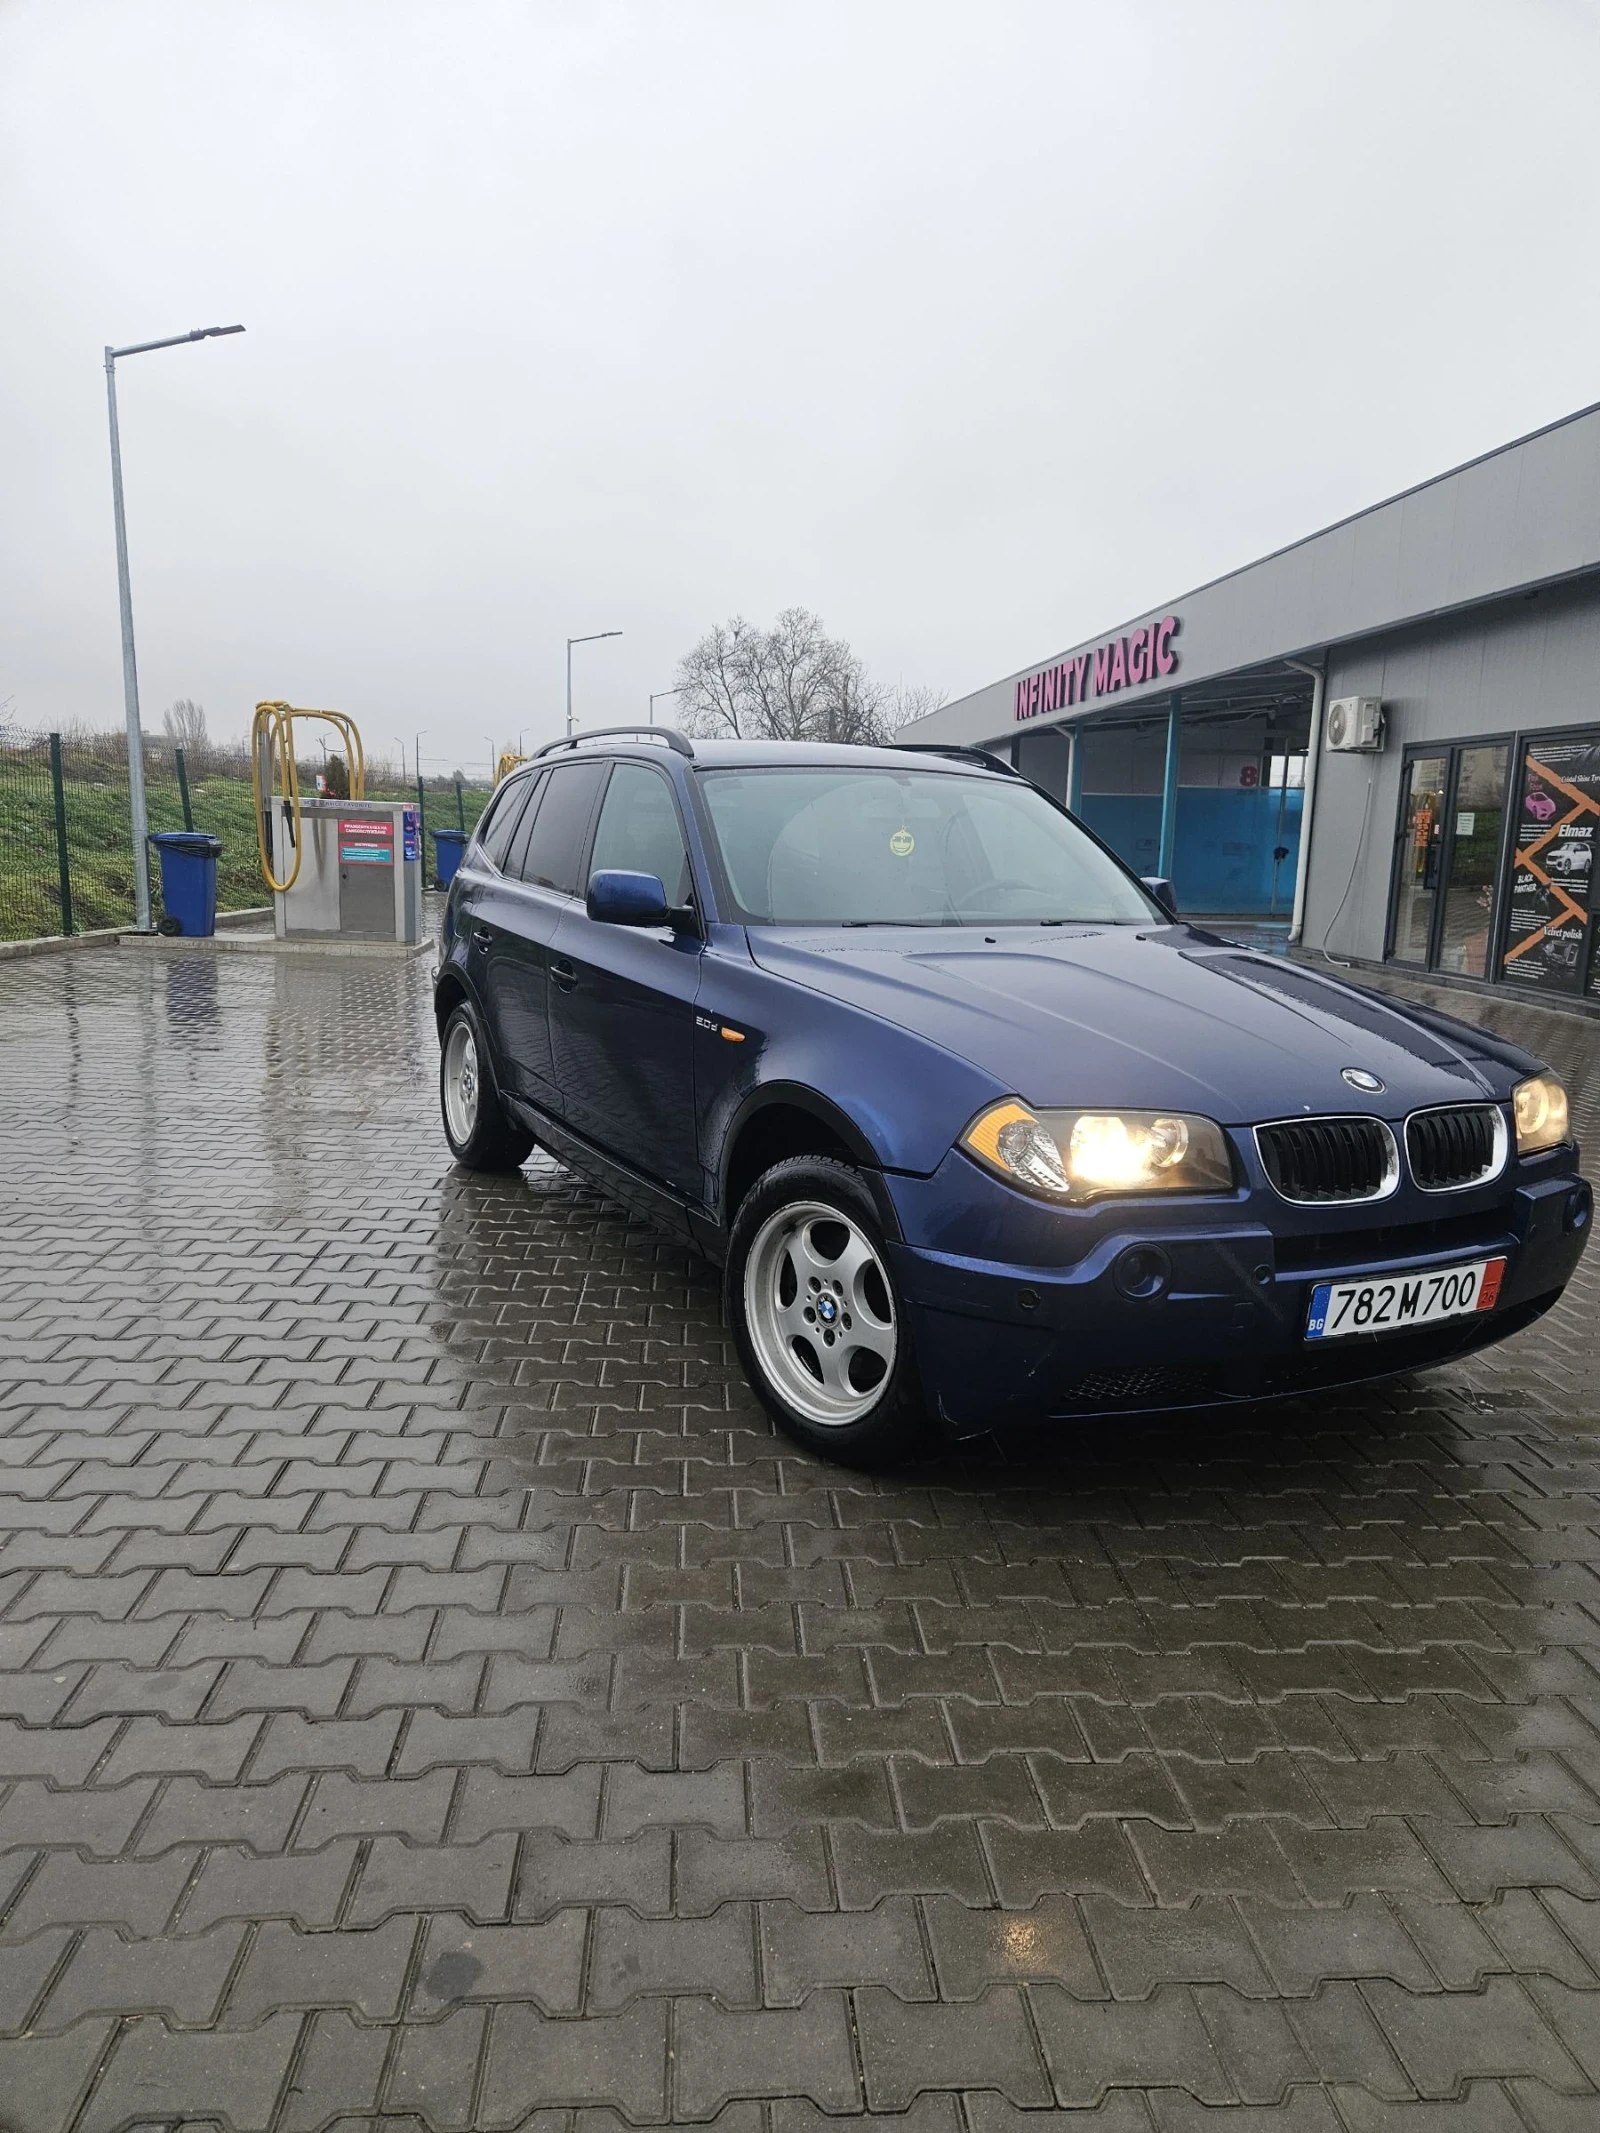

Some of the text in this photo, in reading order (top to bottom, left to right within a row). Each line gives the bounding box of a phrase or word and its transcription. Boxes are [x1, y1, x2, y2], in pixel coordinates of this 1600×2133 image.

[1014, 616, 1178, 720] INFINITY MAGIC
[1239, 765, 1258, 787] 8
[1558, 825, 1593, 837] Elmaz
[1517, 874, 1533, 883] BLACK
[1514, 884, 1537, 893] PANTHER
[1544, 926, 1562, 936] Velvet
[1562, 928, 1582, 940] polish
[1308, 1318, 1325, 1332] BG
